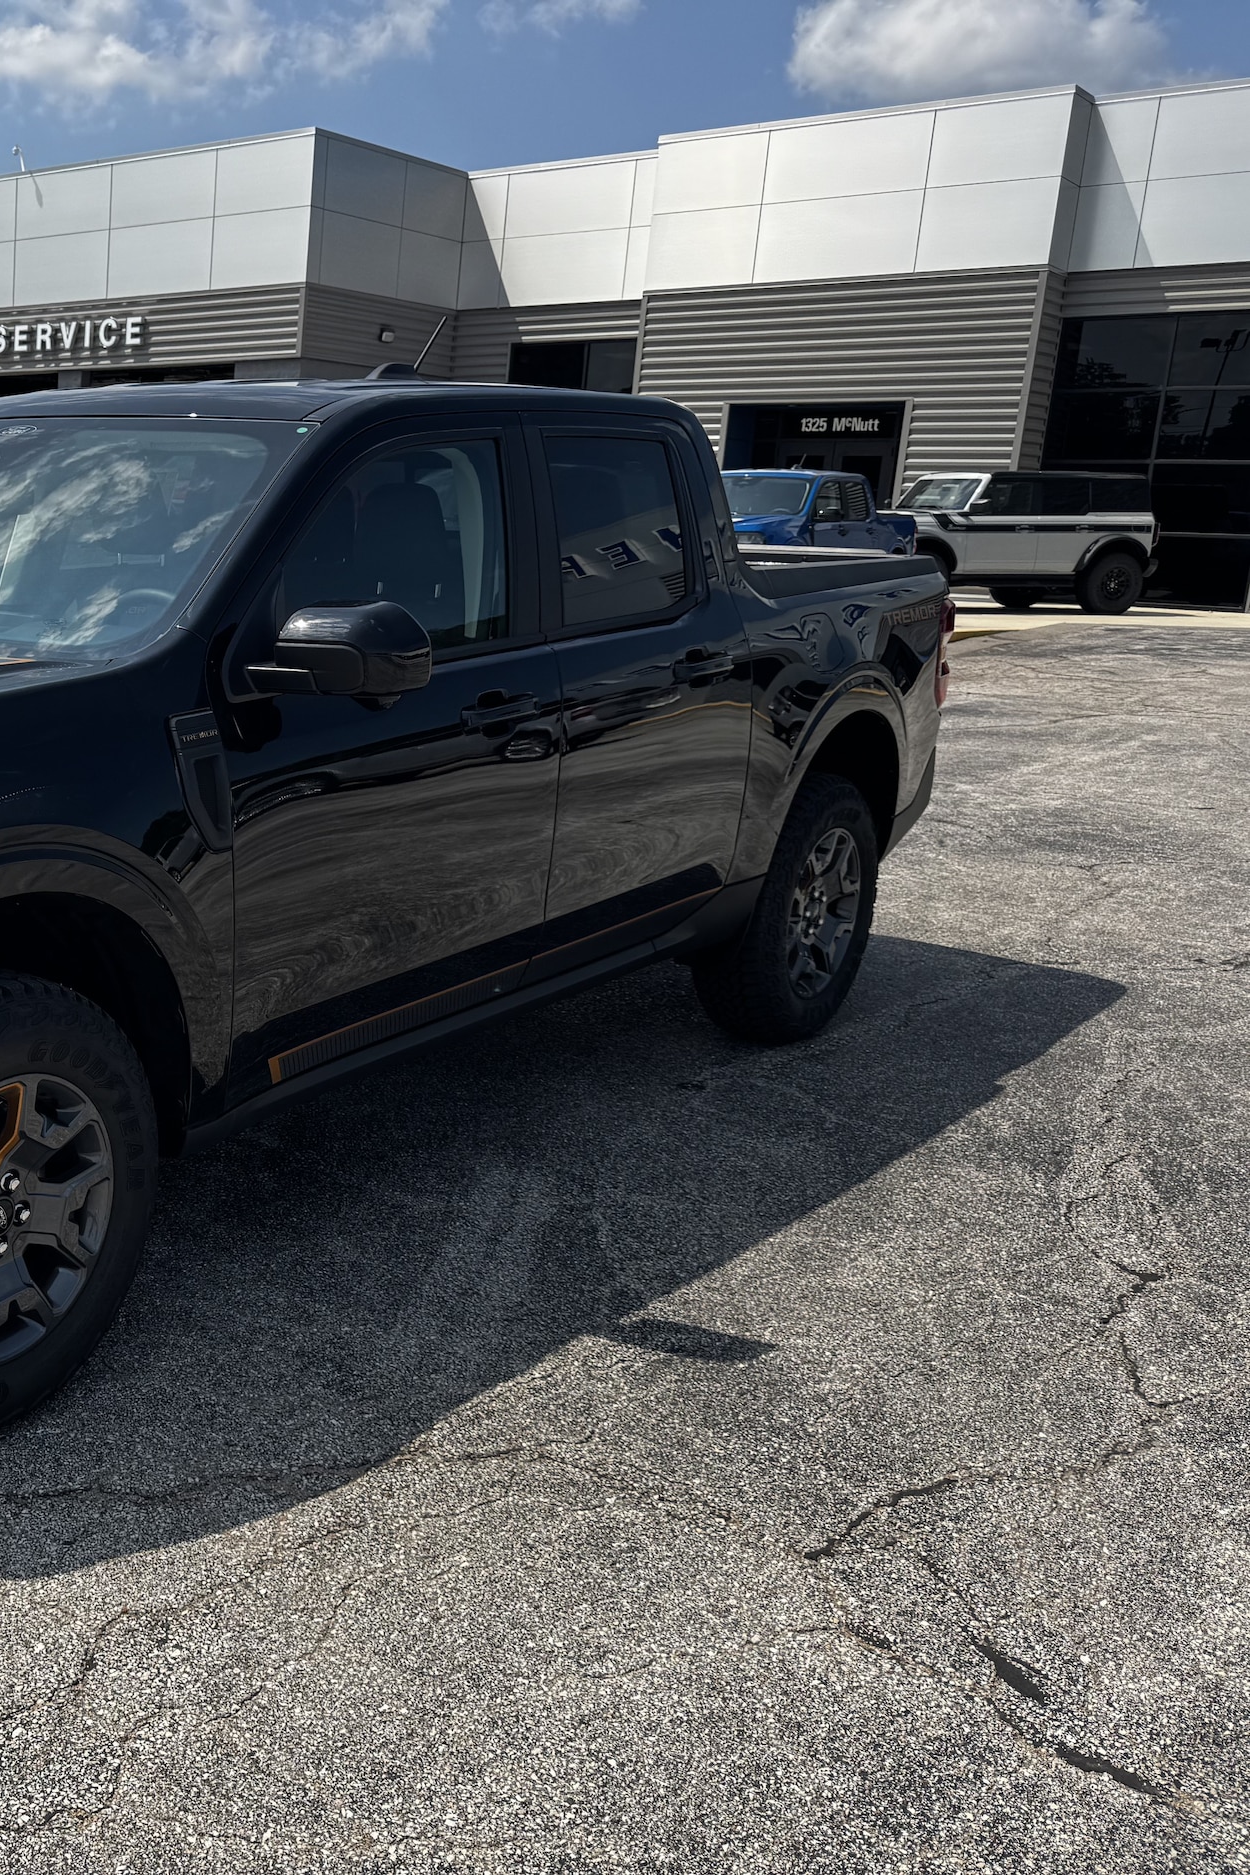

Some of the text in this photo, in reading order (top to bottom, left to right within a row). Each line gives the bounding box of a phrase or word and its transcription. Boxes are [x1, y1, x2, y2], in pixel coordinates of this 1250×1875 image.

[800, 417, 880, 432] 1325 McNutt
[883, 603, 937, 626] TREMOR
[180, 728, 219, 742] TREMOR
